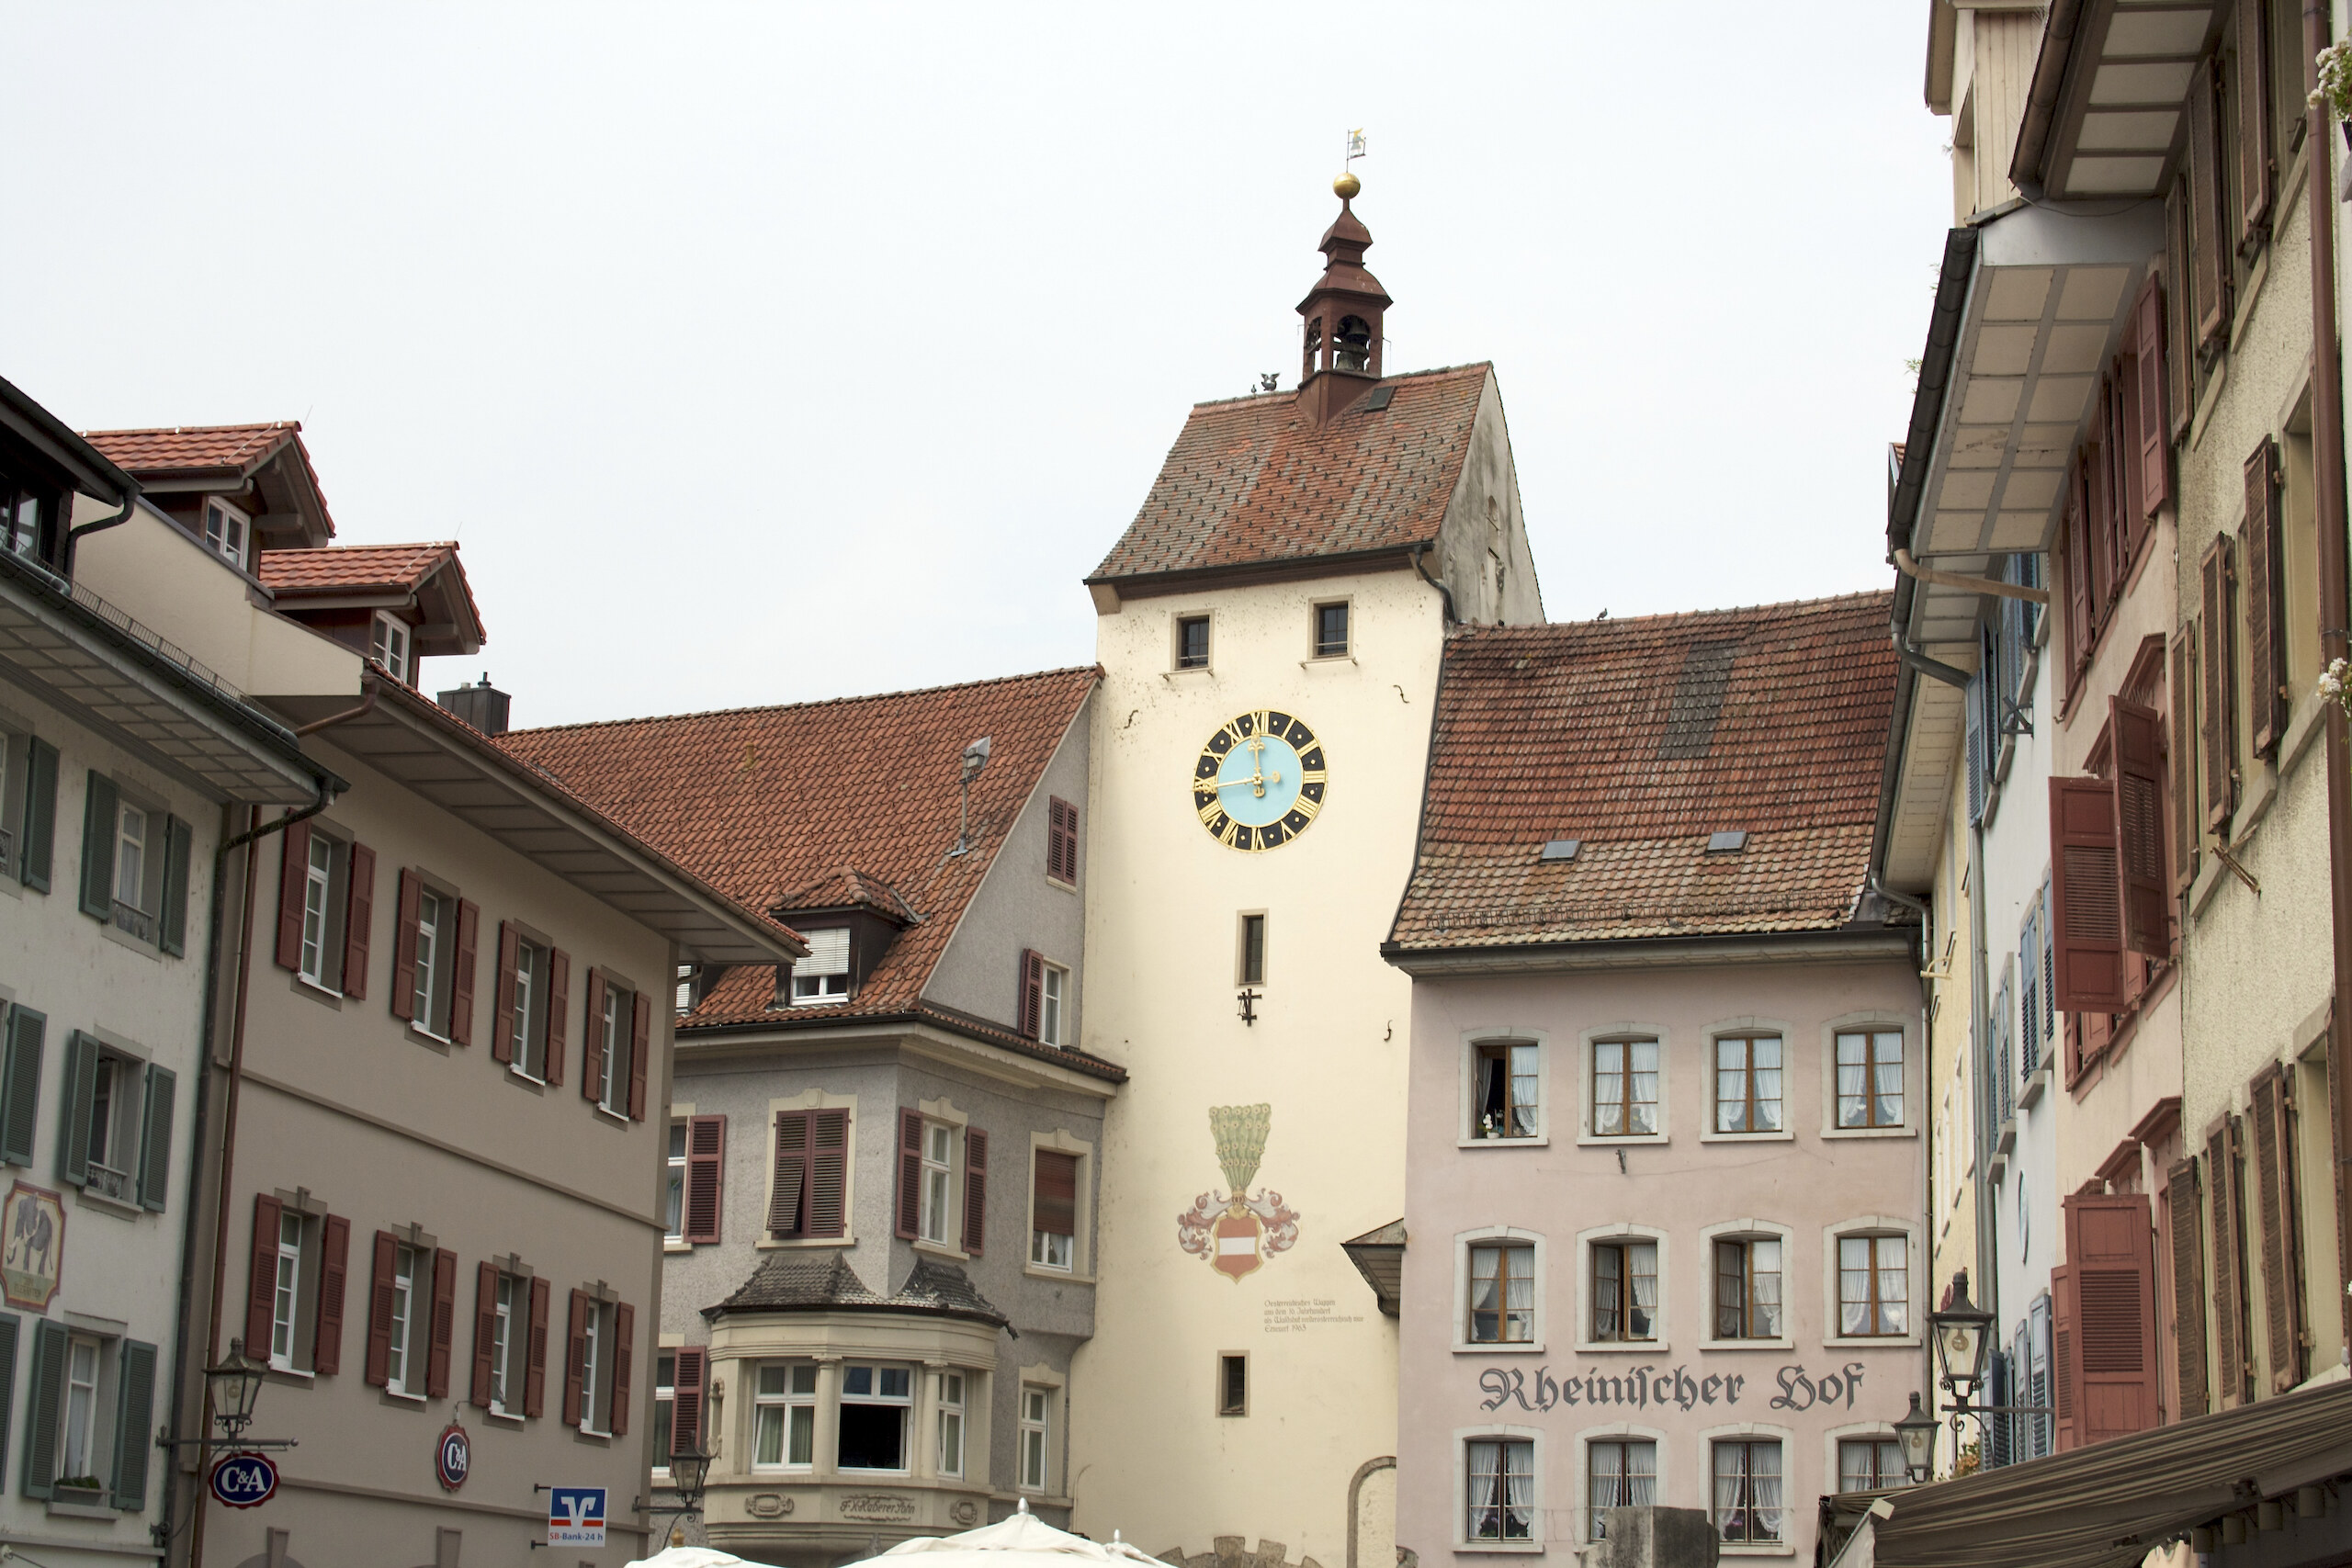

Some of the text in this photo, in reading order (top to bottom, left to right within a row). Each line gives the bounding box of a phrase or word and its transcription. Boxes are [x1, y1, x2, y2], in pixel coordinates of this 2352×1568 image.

[1479, 1362, 1866, 1413] Rheinischer Hof
[447, 1443, 468, 1472] C&A
[221, 1466, 266, 1493] C&A
